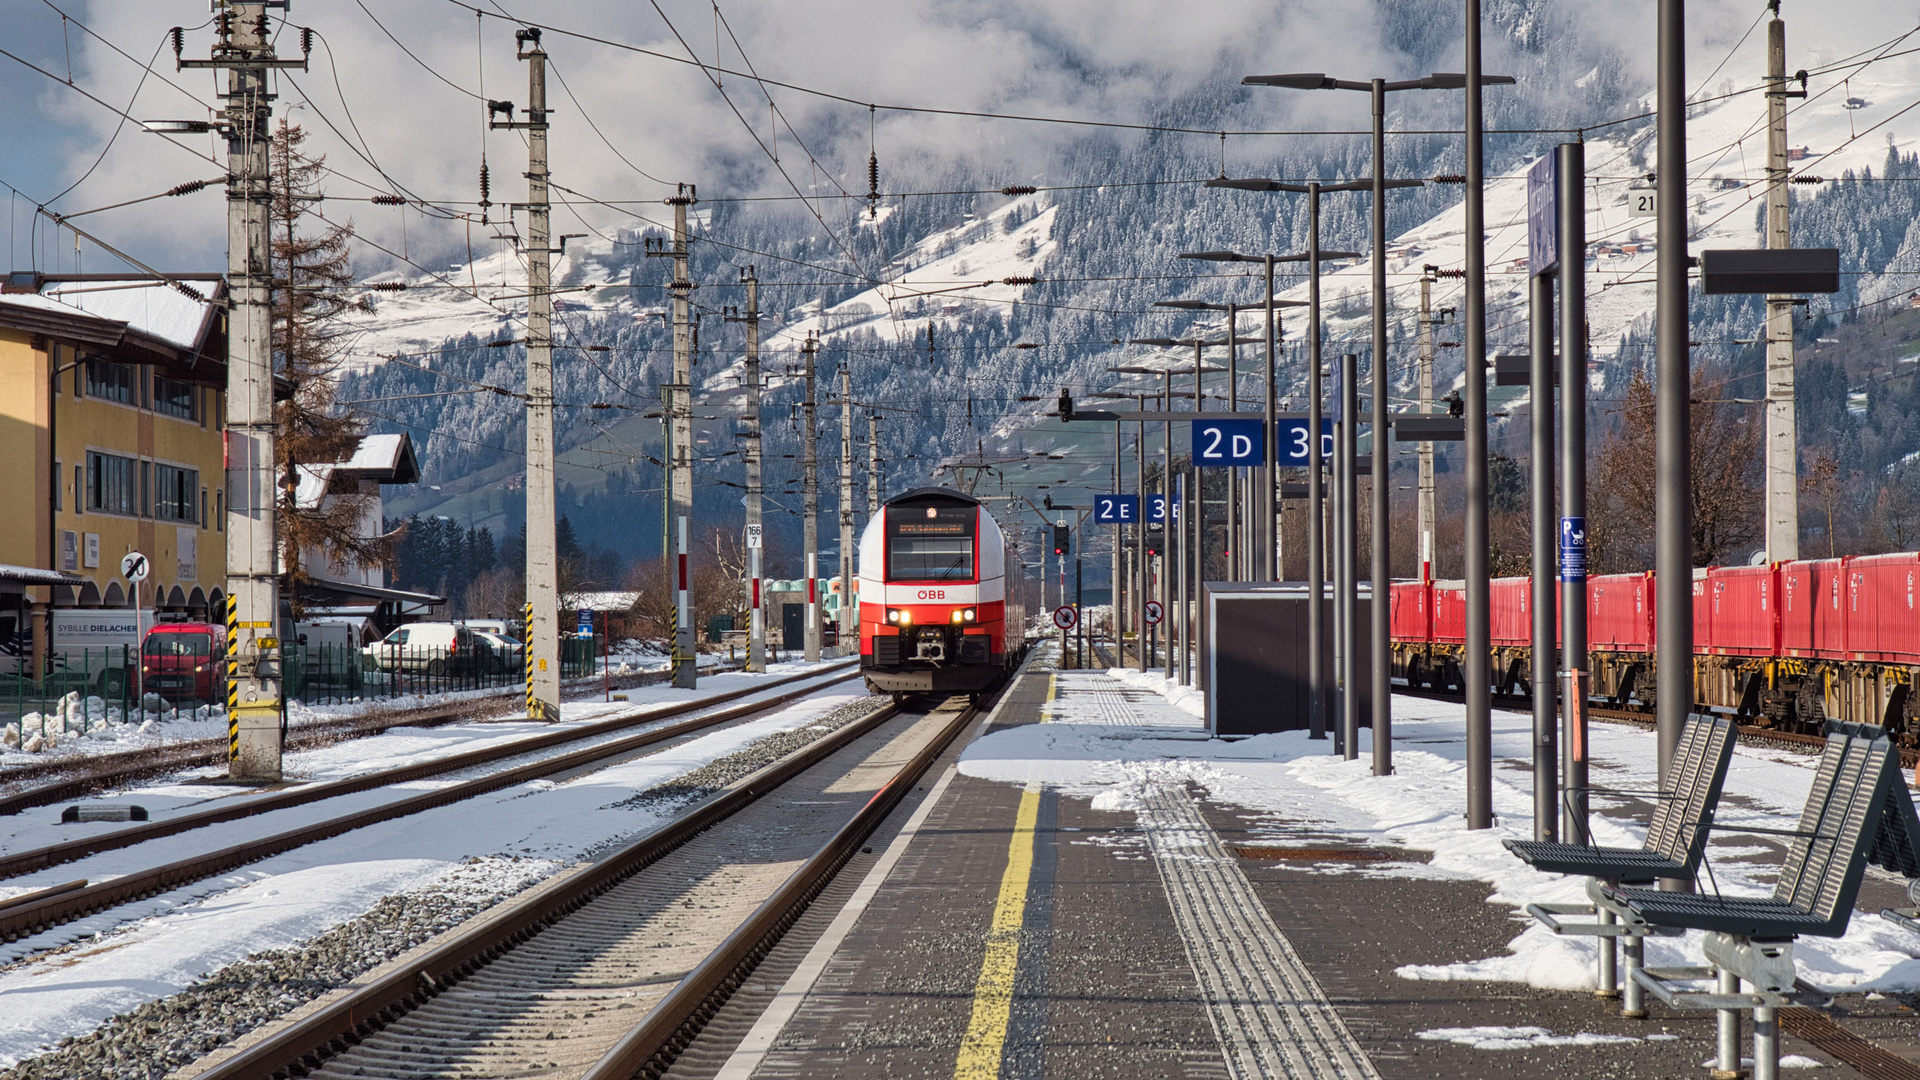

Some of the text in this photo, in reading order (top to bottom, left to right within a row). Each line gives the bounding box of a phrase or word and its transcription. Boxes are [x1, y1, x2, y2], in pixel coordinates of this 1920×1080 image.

[1638, 195, 1654, 211] 21
[1202, 427, 1252, 458] 2 D
[1289, 427, 1309, 458] 3
[1100, 499, 1130, 519] 2 E
[1152, 499, 1165, 519] 3
[748, 526, 761, 535] 166
[1563, 521, 1572, 535] P
[752, 536, 758, 546] 7
[917, 590, 945, 600] ÖBB
[58, 624, 138, 632] SYBILLE DIELACHER
